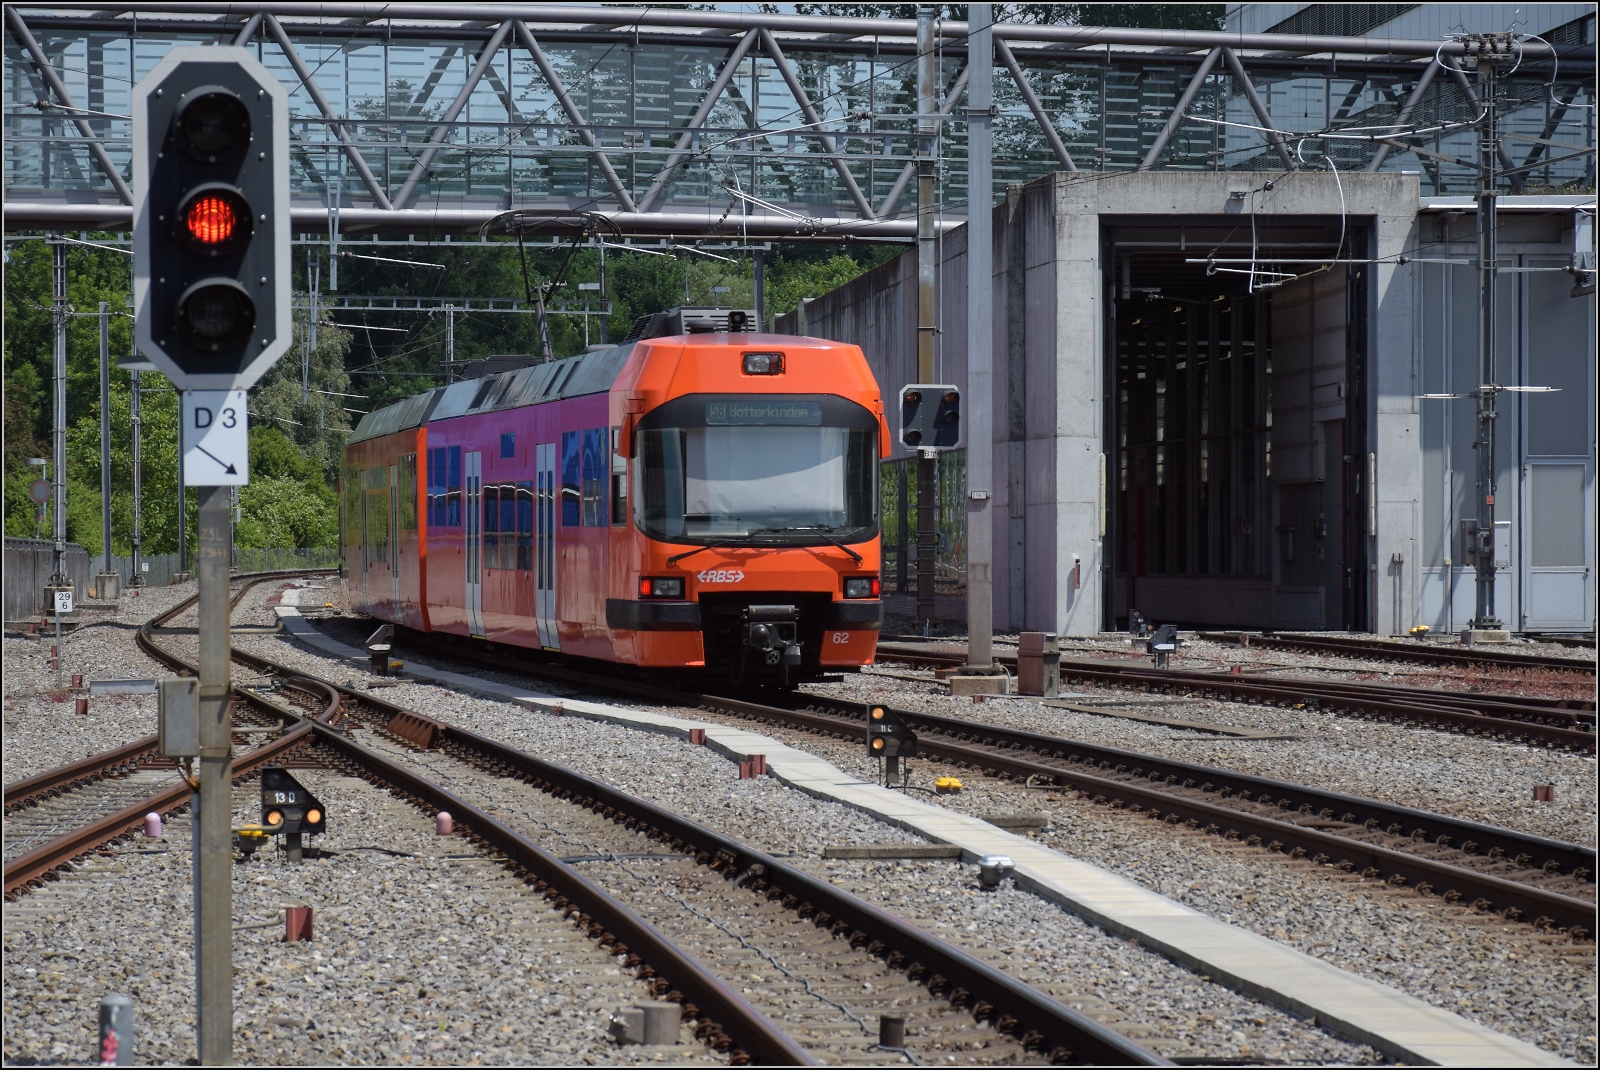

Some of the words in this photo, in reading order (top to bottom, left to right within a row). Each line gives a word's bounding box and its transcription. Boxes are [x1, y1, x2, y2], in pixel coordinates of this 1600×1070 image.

[195, 407, 213, 428] D
[222, 407, 237, 428] 3
[705, 570, 736, 583] RBS
[58, 593, 71, 601] 29
[62, 602, 68, 610] 6
[832, 633, 849, 644] 62
[274, 792, 286, 804] 13
[288, 792, 296, 804] D
